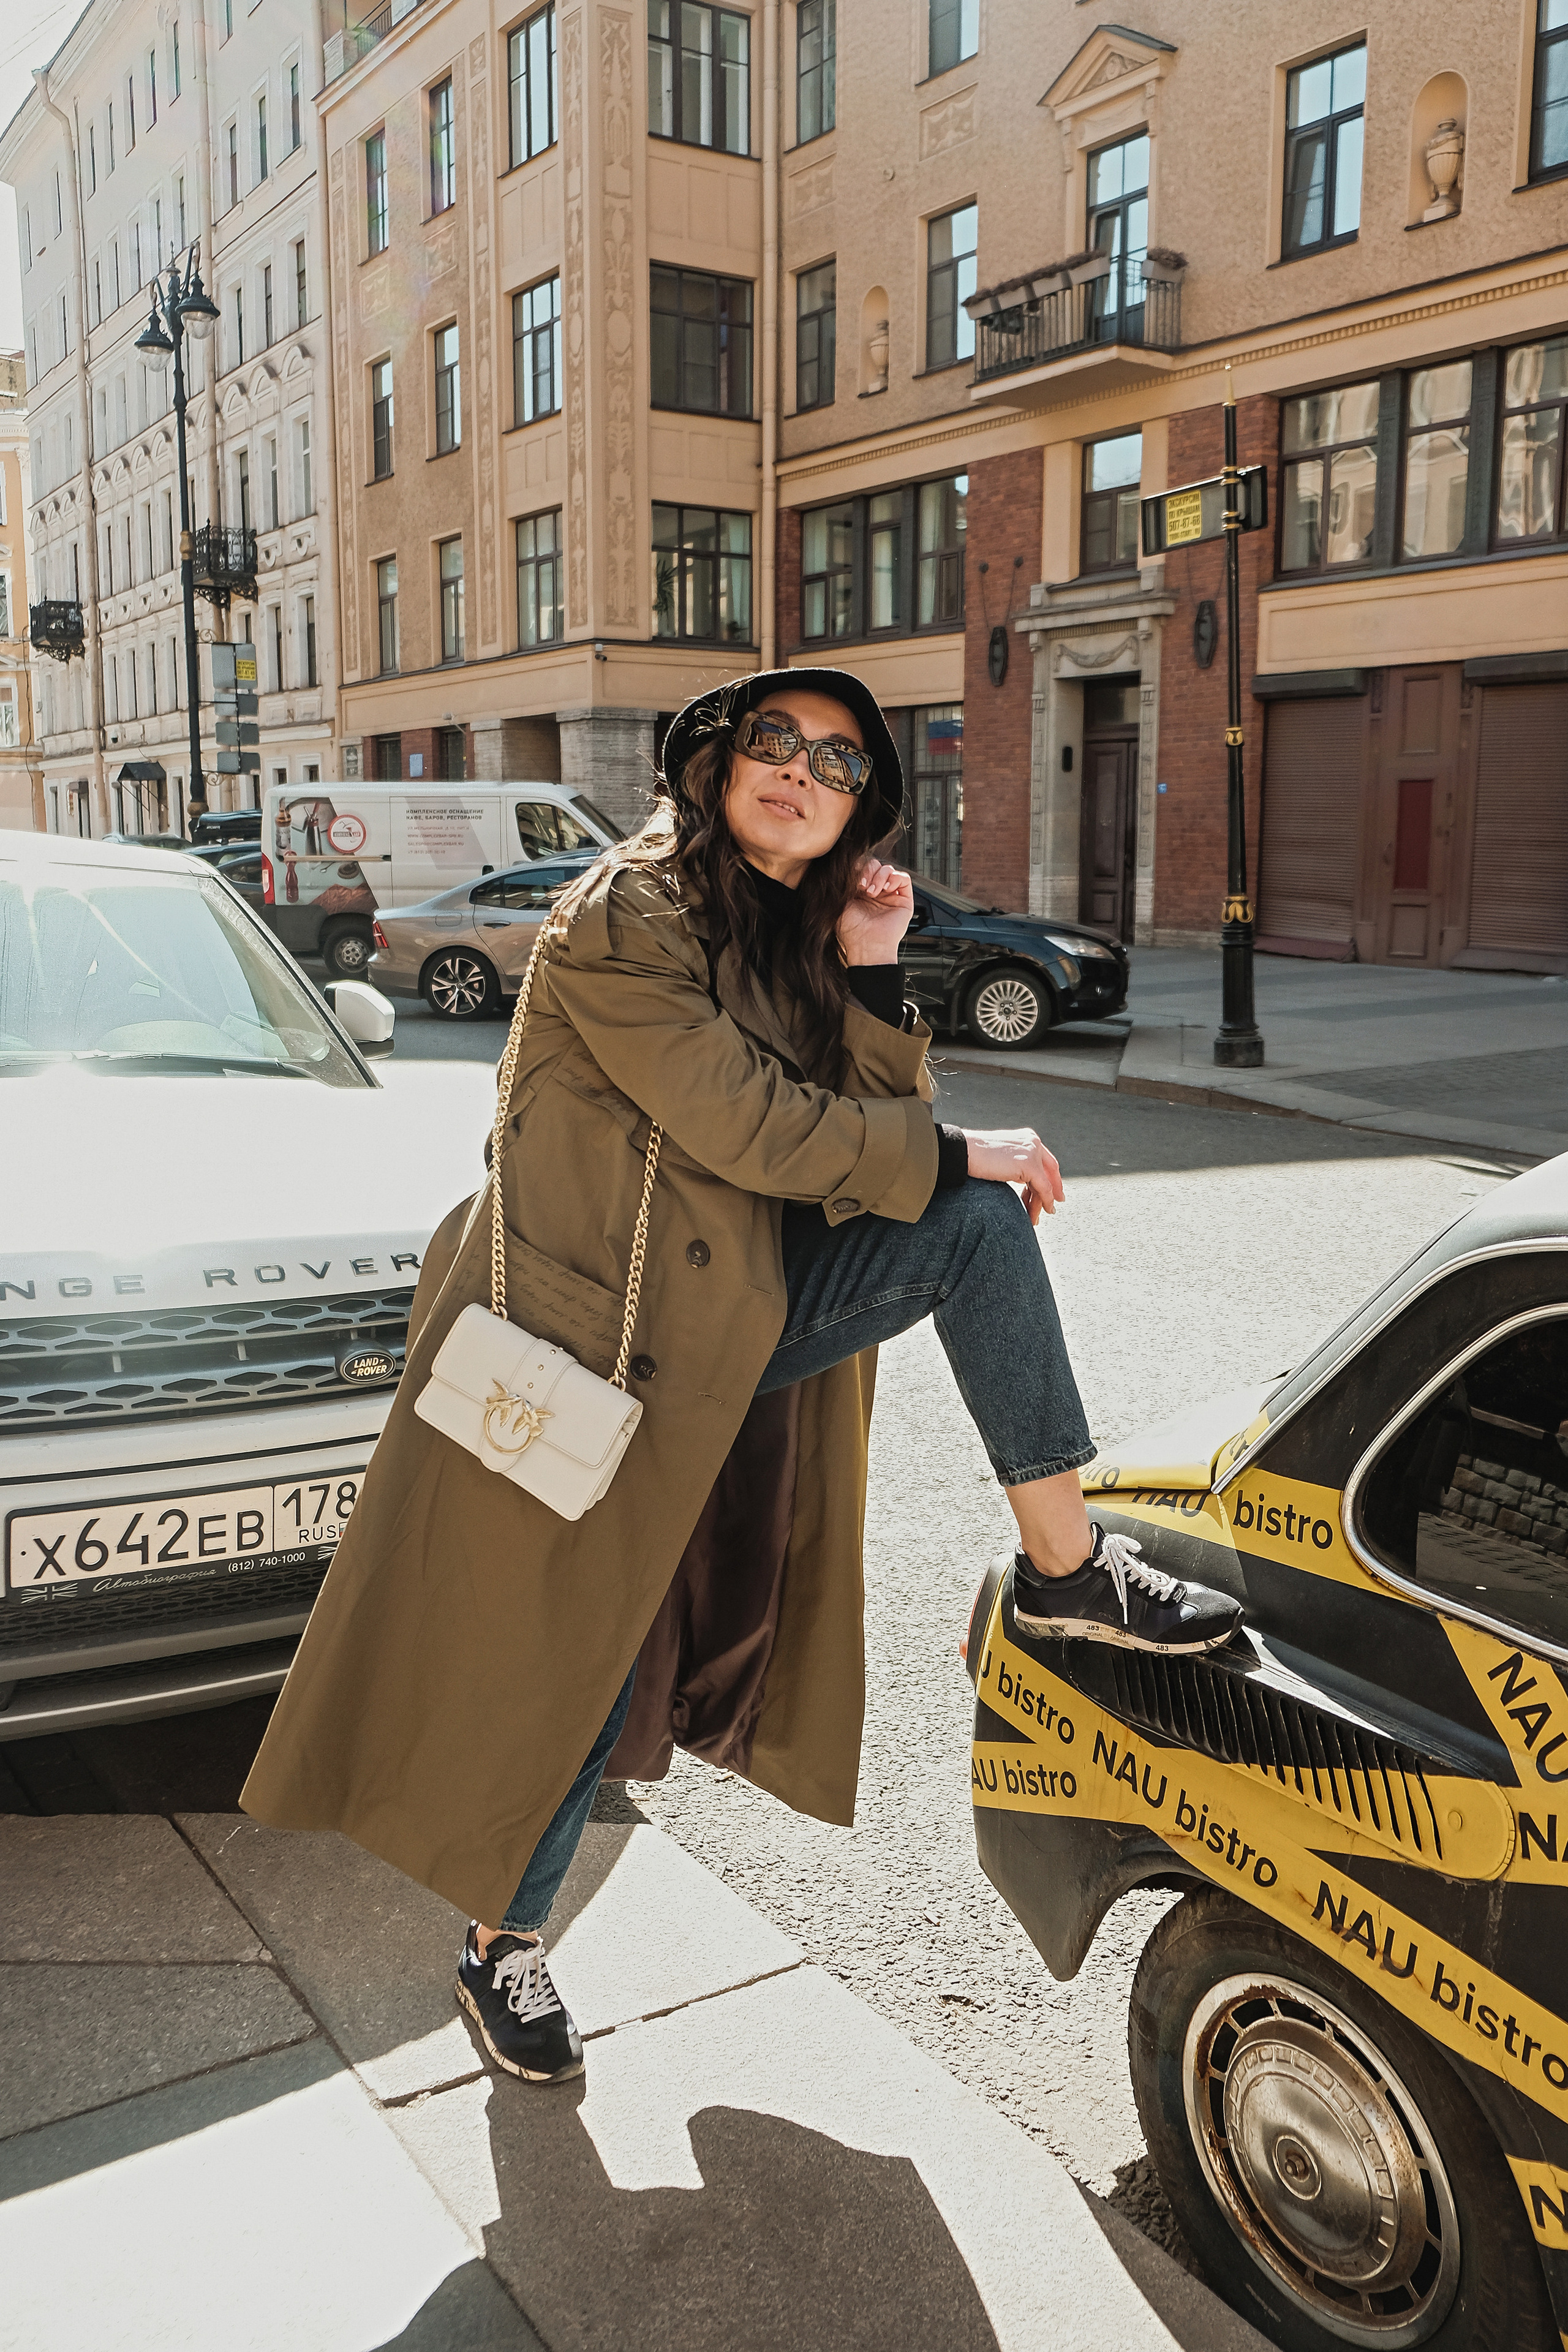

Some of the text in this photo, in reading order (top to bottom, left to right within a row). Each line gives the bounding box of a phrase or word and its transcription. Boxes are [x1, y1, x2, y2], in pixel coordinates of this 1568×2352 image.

[203, 1251, 422, 1287] ROVER
[353, 1357, 379, 1368] LAND
[356, 1365, 387, 1377] ROVER
[282, 1481, 357, 1526] 178
[1232, 1490, 1334, 1550] bistro
[299, 1525, 337, 1544] RUS
[228, 1552, 306, 1573] (812) 740-1000
[997, 1660, 1075, 1744] bistro
[1002, 1759, 1077, 1798] bistro
[1092, 1729, 1278, 1887] NAU bistro
[1518, 1812, 1568, 1863] N
[1311, 1880, 1568, 2091] NAU bistro
